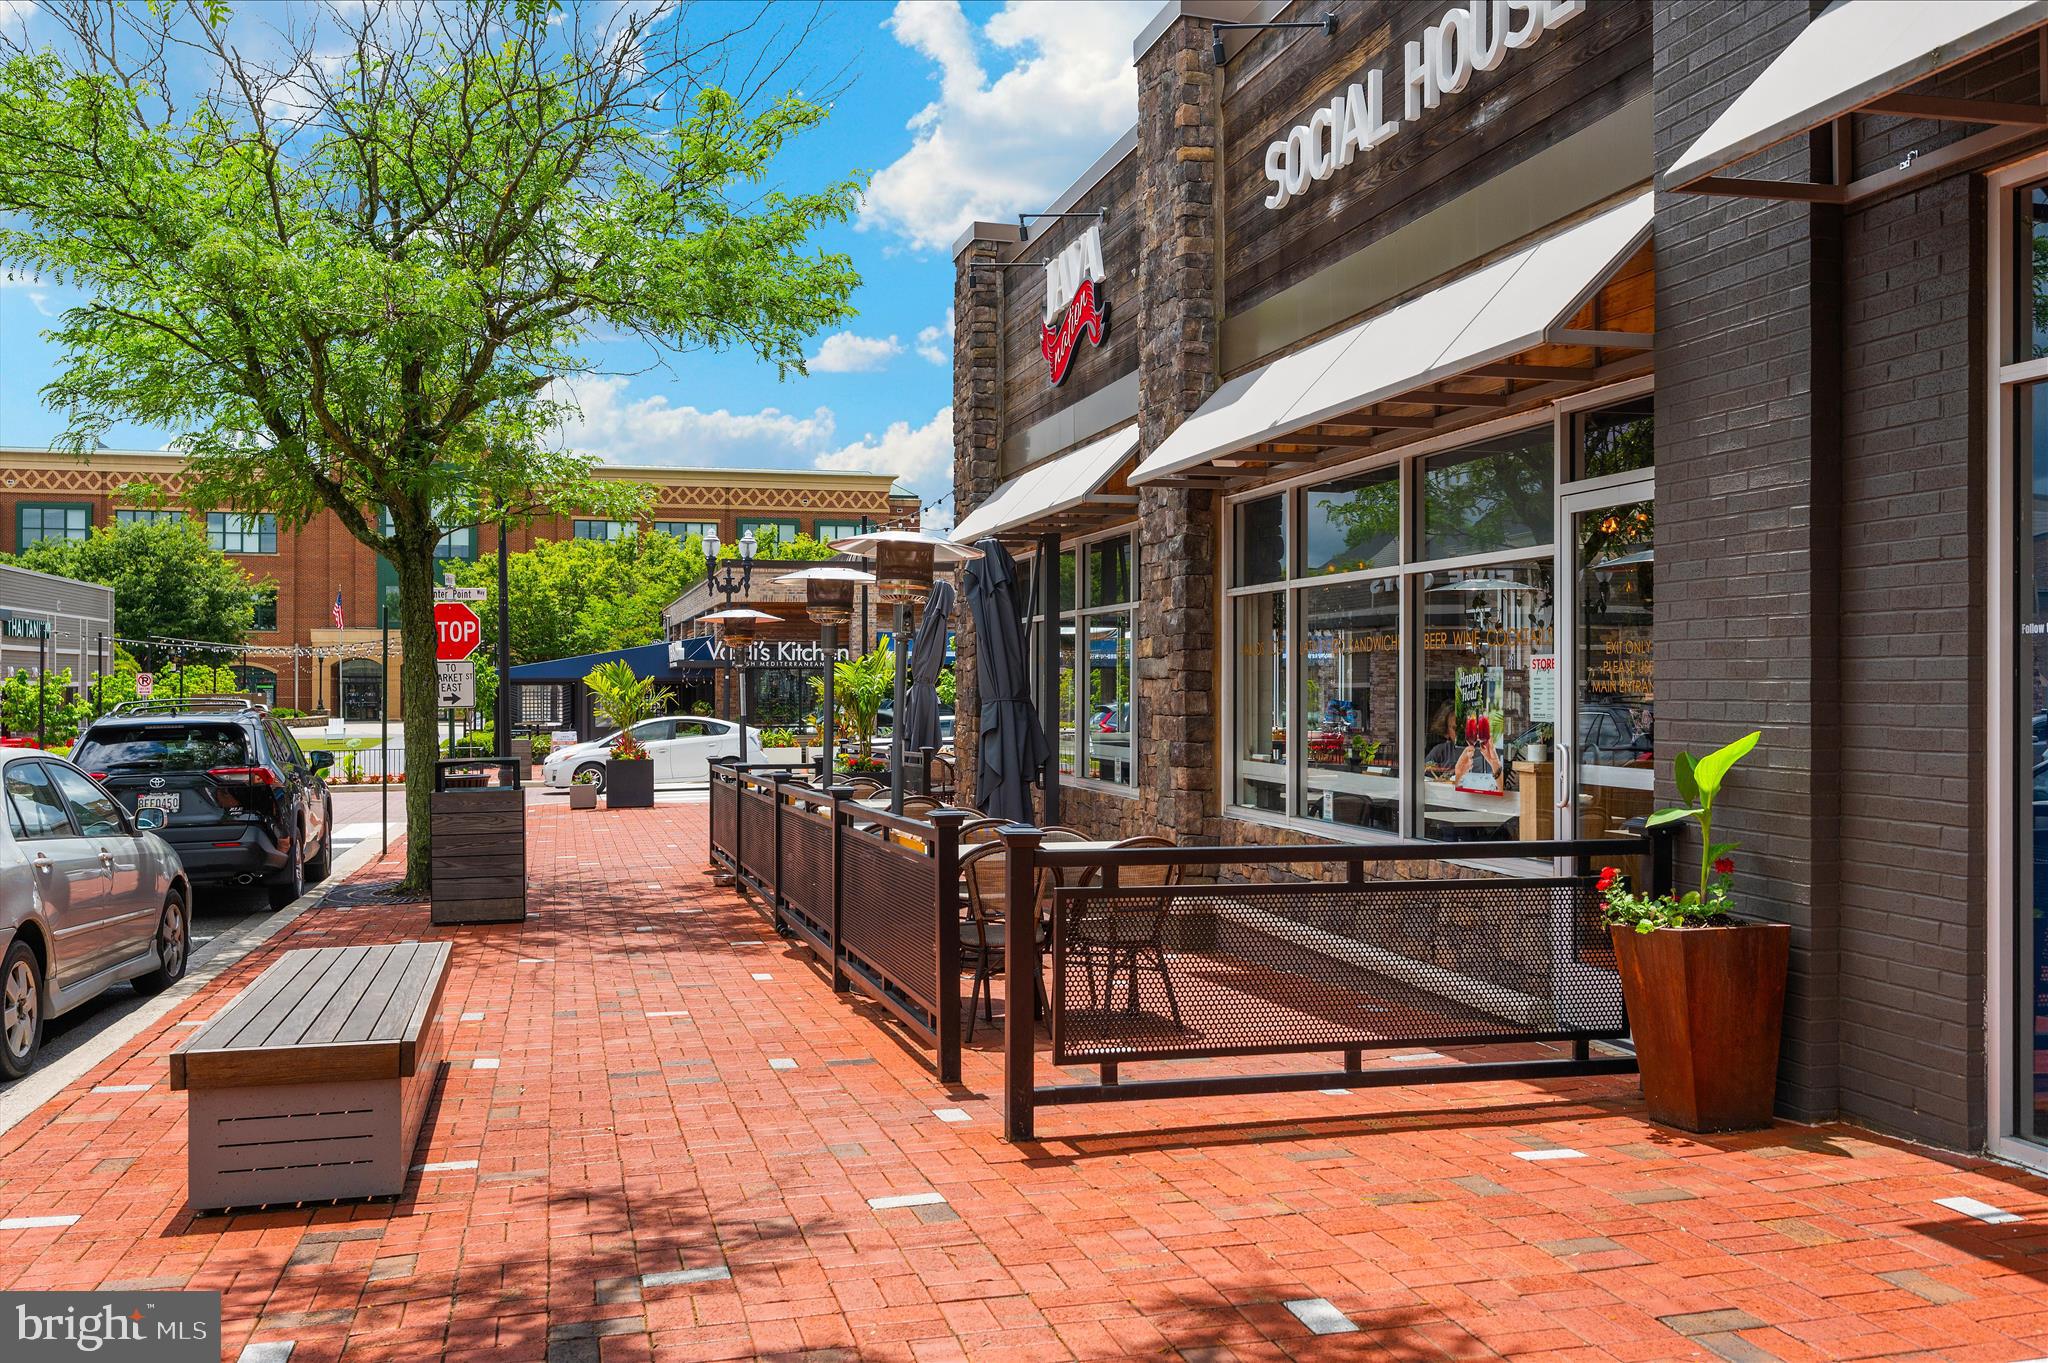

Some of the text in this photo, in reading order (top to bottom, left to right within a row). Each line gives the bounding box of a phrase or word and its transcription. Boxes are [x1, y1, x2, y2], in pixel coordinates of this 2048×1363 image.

[1265, 69, 1399, 210] SOCIAL
[433, 590, 447, 598] nter
[453, 589, 471, 598] Point
[437, 621, 476, 643] TOP
[2021, 624, 2045, 634] Follow
[1348, 634, 1401, 654] SANDWICH
[1424, 631, 1447, 650] BEER
[1453, 629, 1480, 647] WINE
[778, 640, 849, 661] Kitchn
[1606, 641, 1622, 654] EXIT
[446, 664, 456, 672] TO
[1603, 660, 1635, 674] PLEASE
[439, 674, 462, 682] ARKET
[1460, 671, 1481, 689] Happy
[441, 683, 462, 692] EAST
[1592, 680, 1654, 694] MAIN ENTRAN
[1461, 687, 1478, 702] Hour
